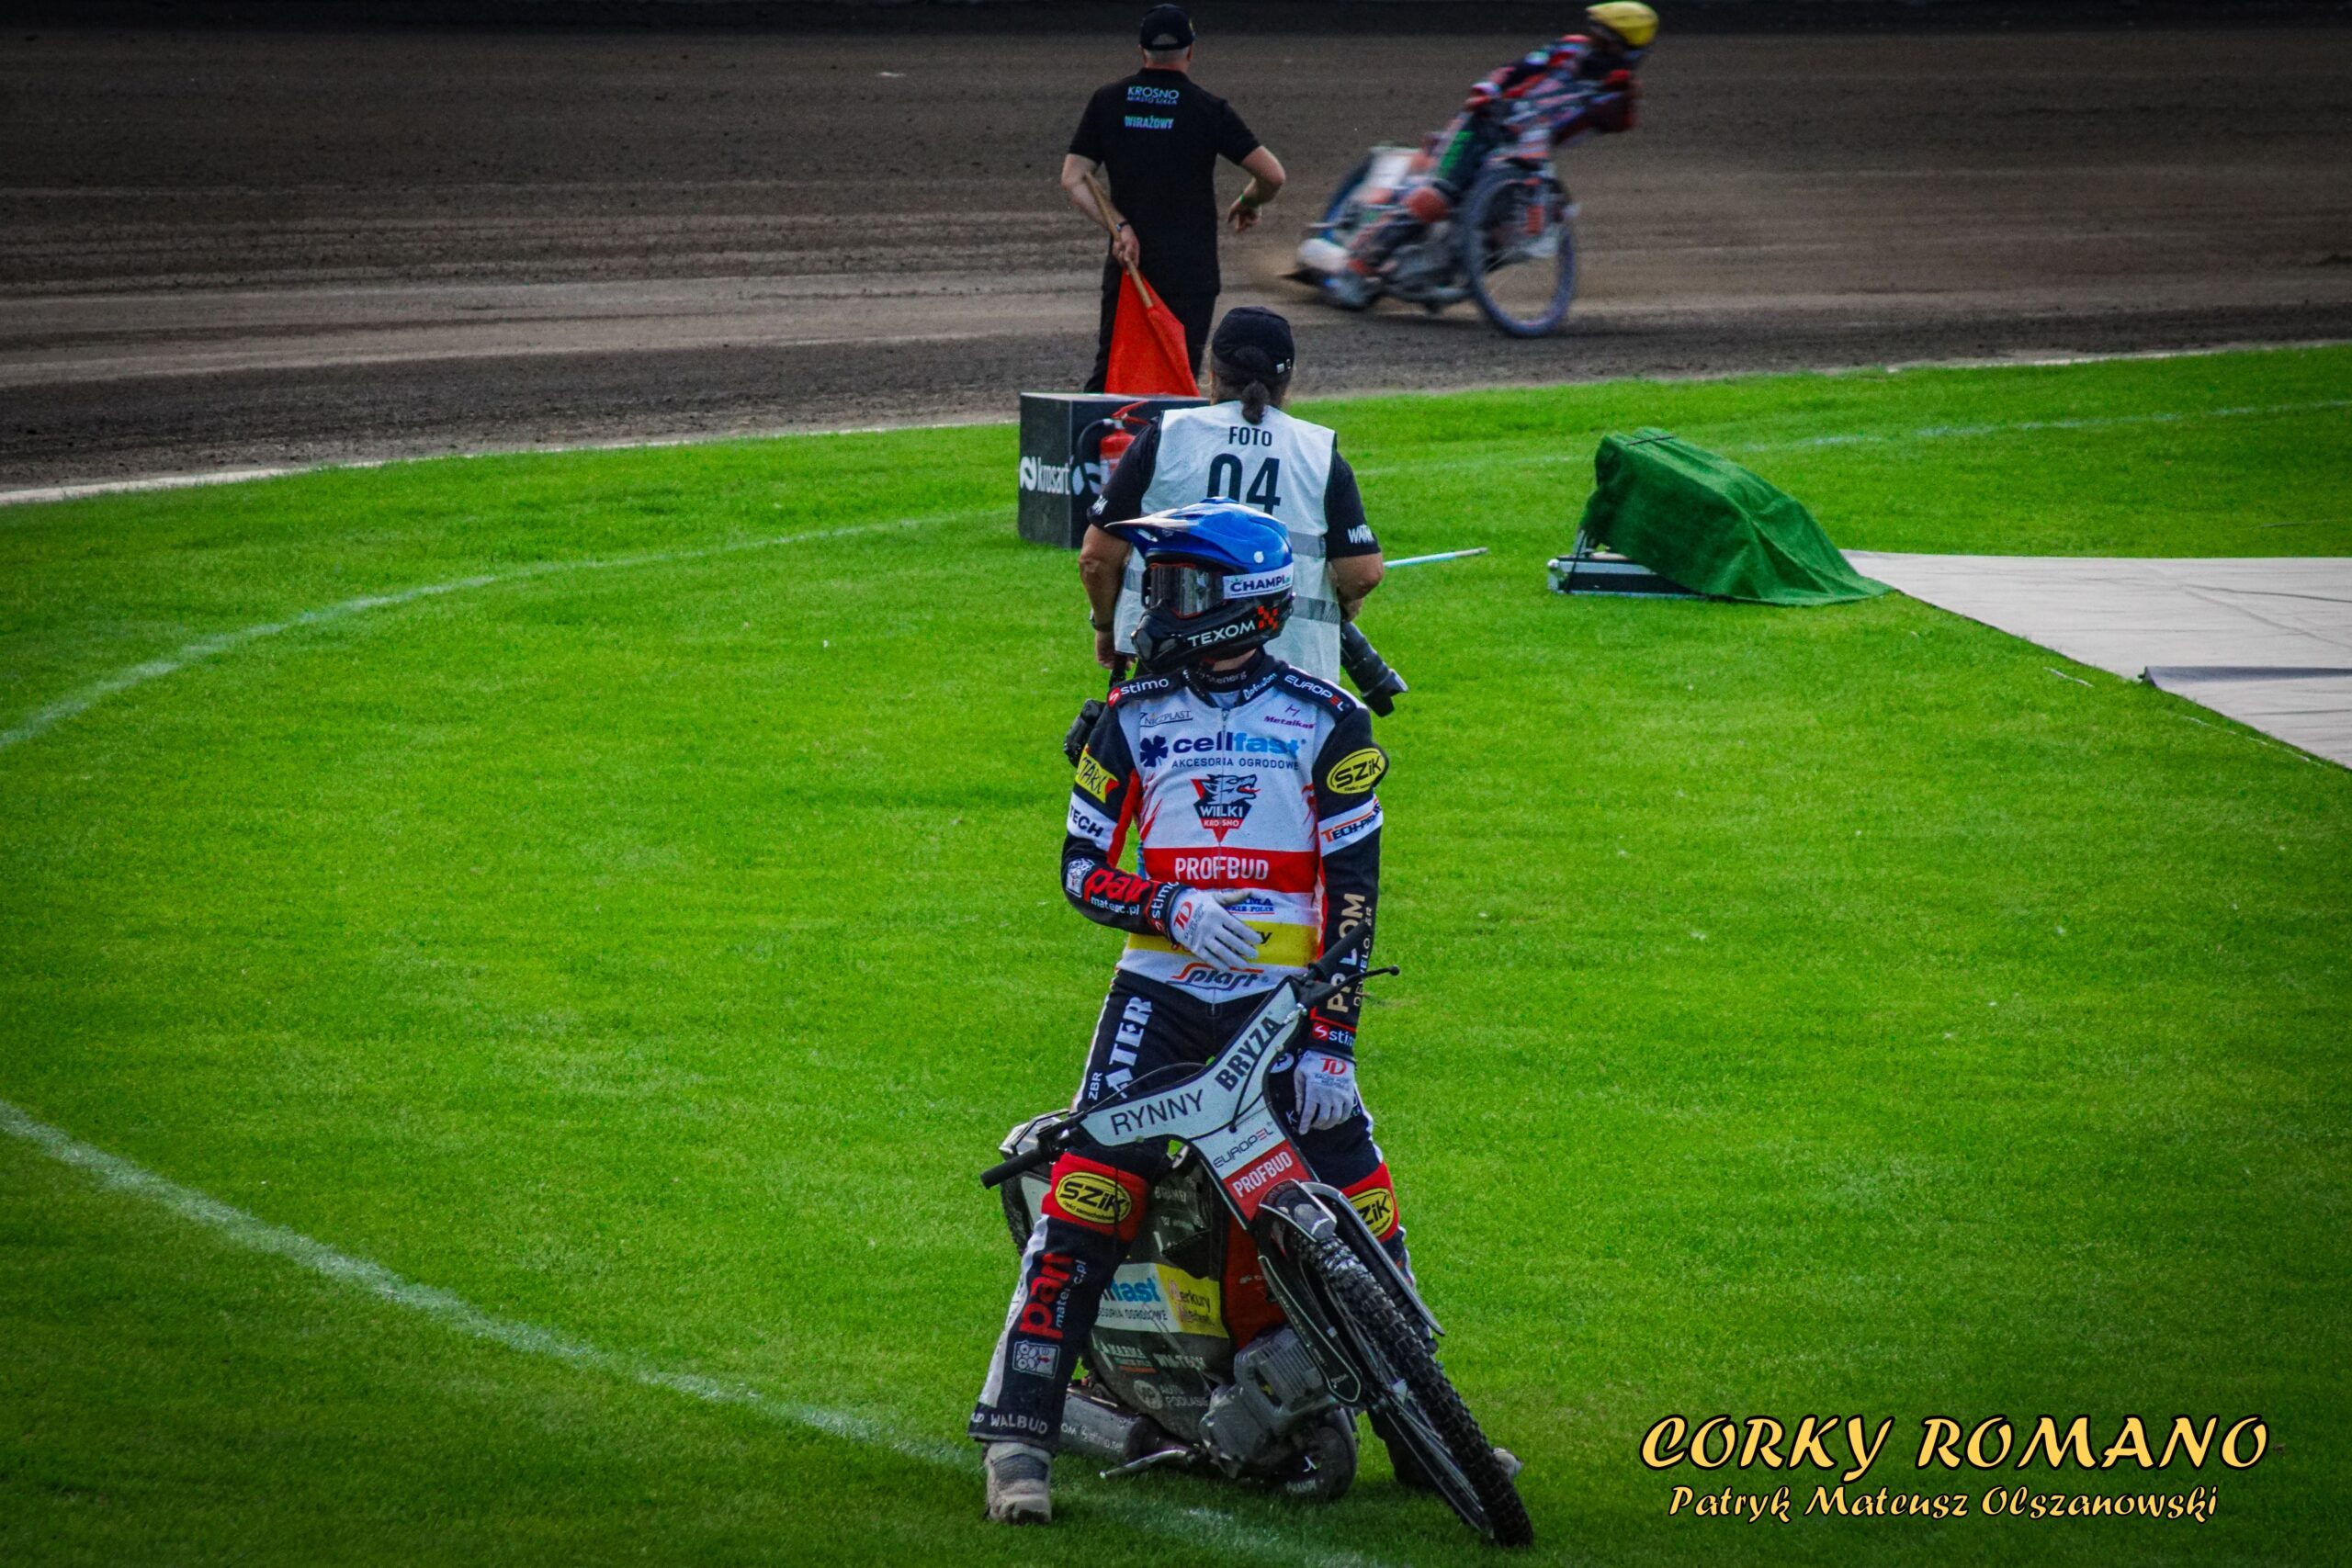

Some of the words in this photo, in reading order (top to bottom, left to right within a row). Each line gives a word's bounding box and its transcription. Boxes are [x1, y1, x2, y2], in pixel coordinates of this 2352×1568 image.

[1127, 85, 1180, 100] KROSNO
[1228, 425, 1272, 446] FOTO
[1206, 453, 1281, 515] 04
[1187, 620, 1256, 647] TEXOM
[1120, 678, 1170, 695] stimo
[1284, 674, 1344, 712] EUROPEL
[1264, 716, 1315, 729] Metalkas
[1173, 730, 1300, 758] cellfast
[1171, 757, 1234, 769] AKCESORIA
[1238, 758, 1299, 771] OGRODOWE
[1069, 805, 1104, 838] TECH
[1200, 805, 1244, 818] WILKI
[1175, 856, 1269, 881] PROFBUD
[1088, 1072, 1102, 1100] ZBR
[1110, 1089, 1204, 1135] RYNNY
[1215, 1016, 1283, 1092] BRYZA
[1212, 1127, 1274, 1168] EUROPEL
[1232, 1151, 1294, 1198] PROFBUD
[1357, 1195, 1391, 1226] ZiK
[1018, 1252, 1073, 1339] pan
[990, 1414, 1048, 1435] WALBUD
